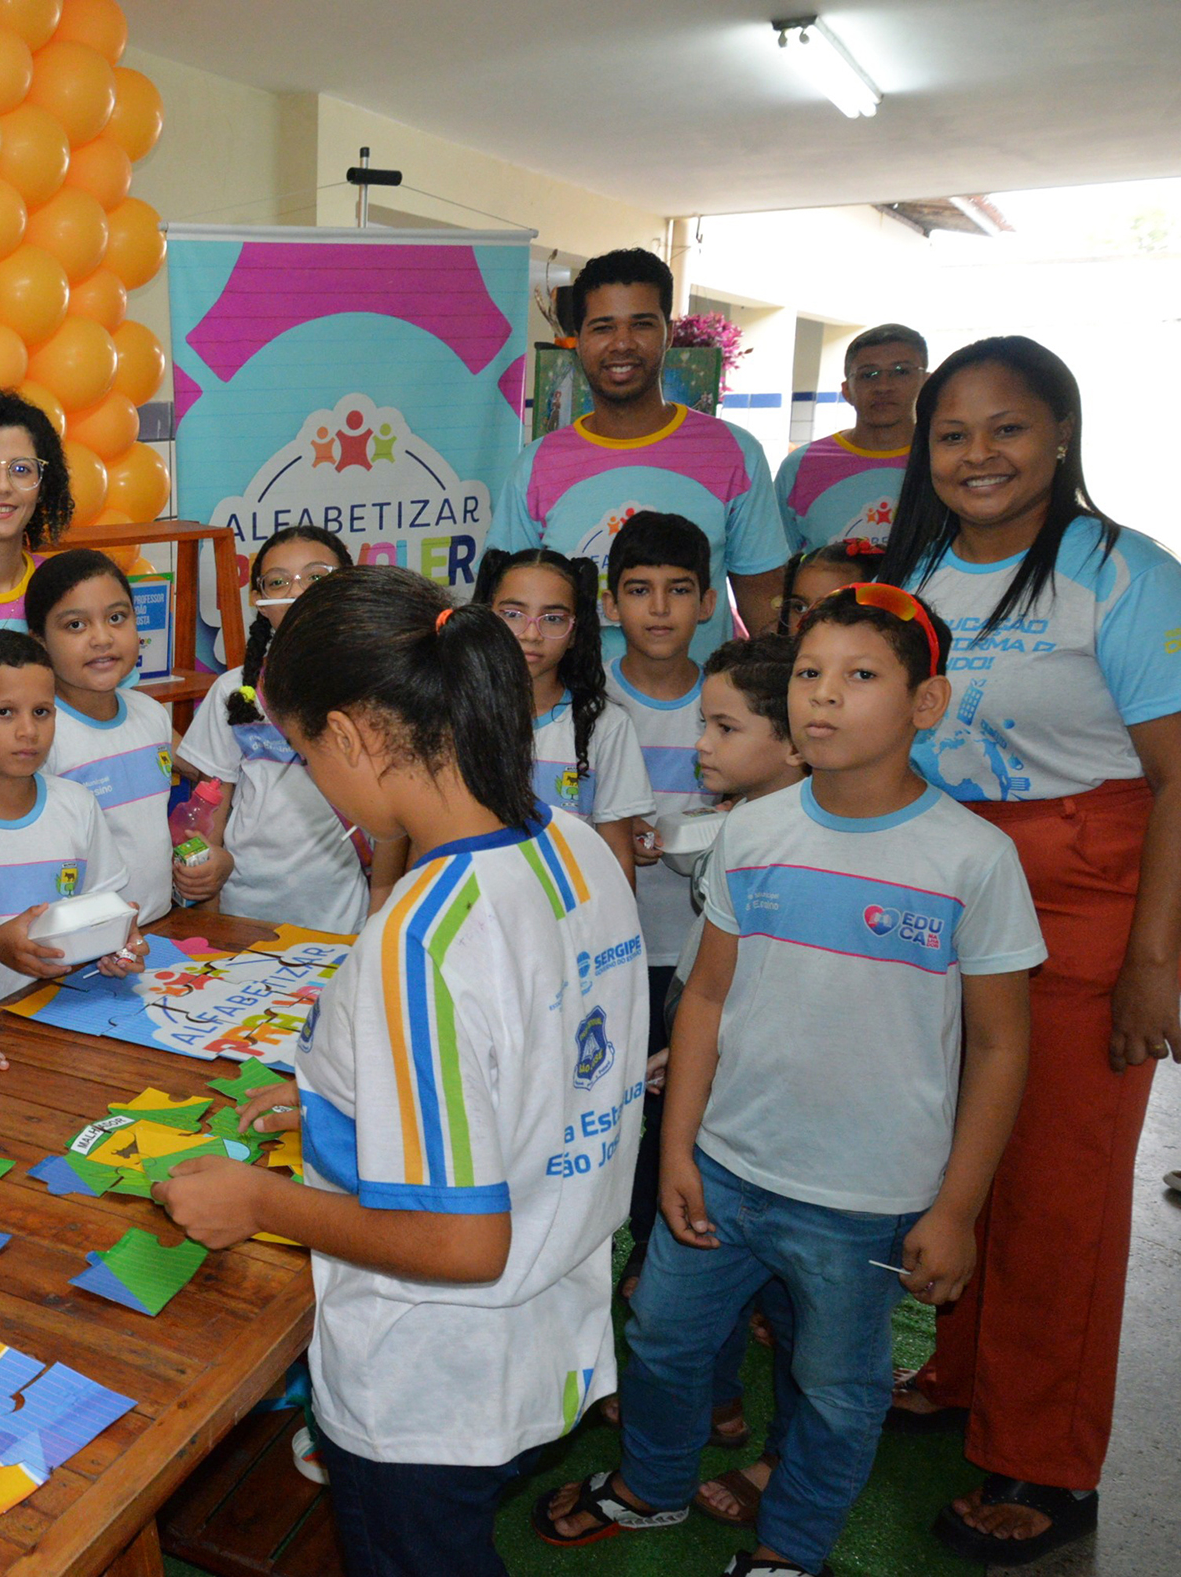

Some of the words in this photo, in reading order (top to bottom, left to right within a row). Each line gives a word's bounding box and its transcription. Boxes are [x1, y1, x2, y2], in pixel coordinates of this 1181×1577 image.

[136, 615, 151, 625] OSTA
[902, 911, 943, 934] EDU
[899, 926, 926, 946] CA
[594, 934, 641, 970] SERGIPE
[171, 946, 335, 1046] ALFABETIZAR
